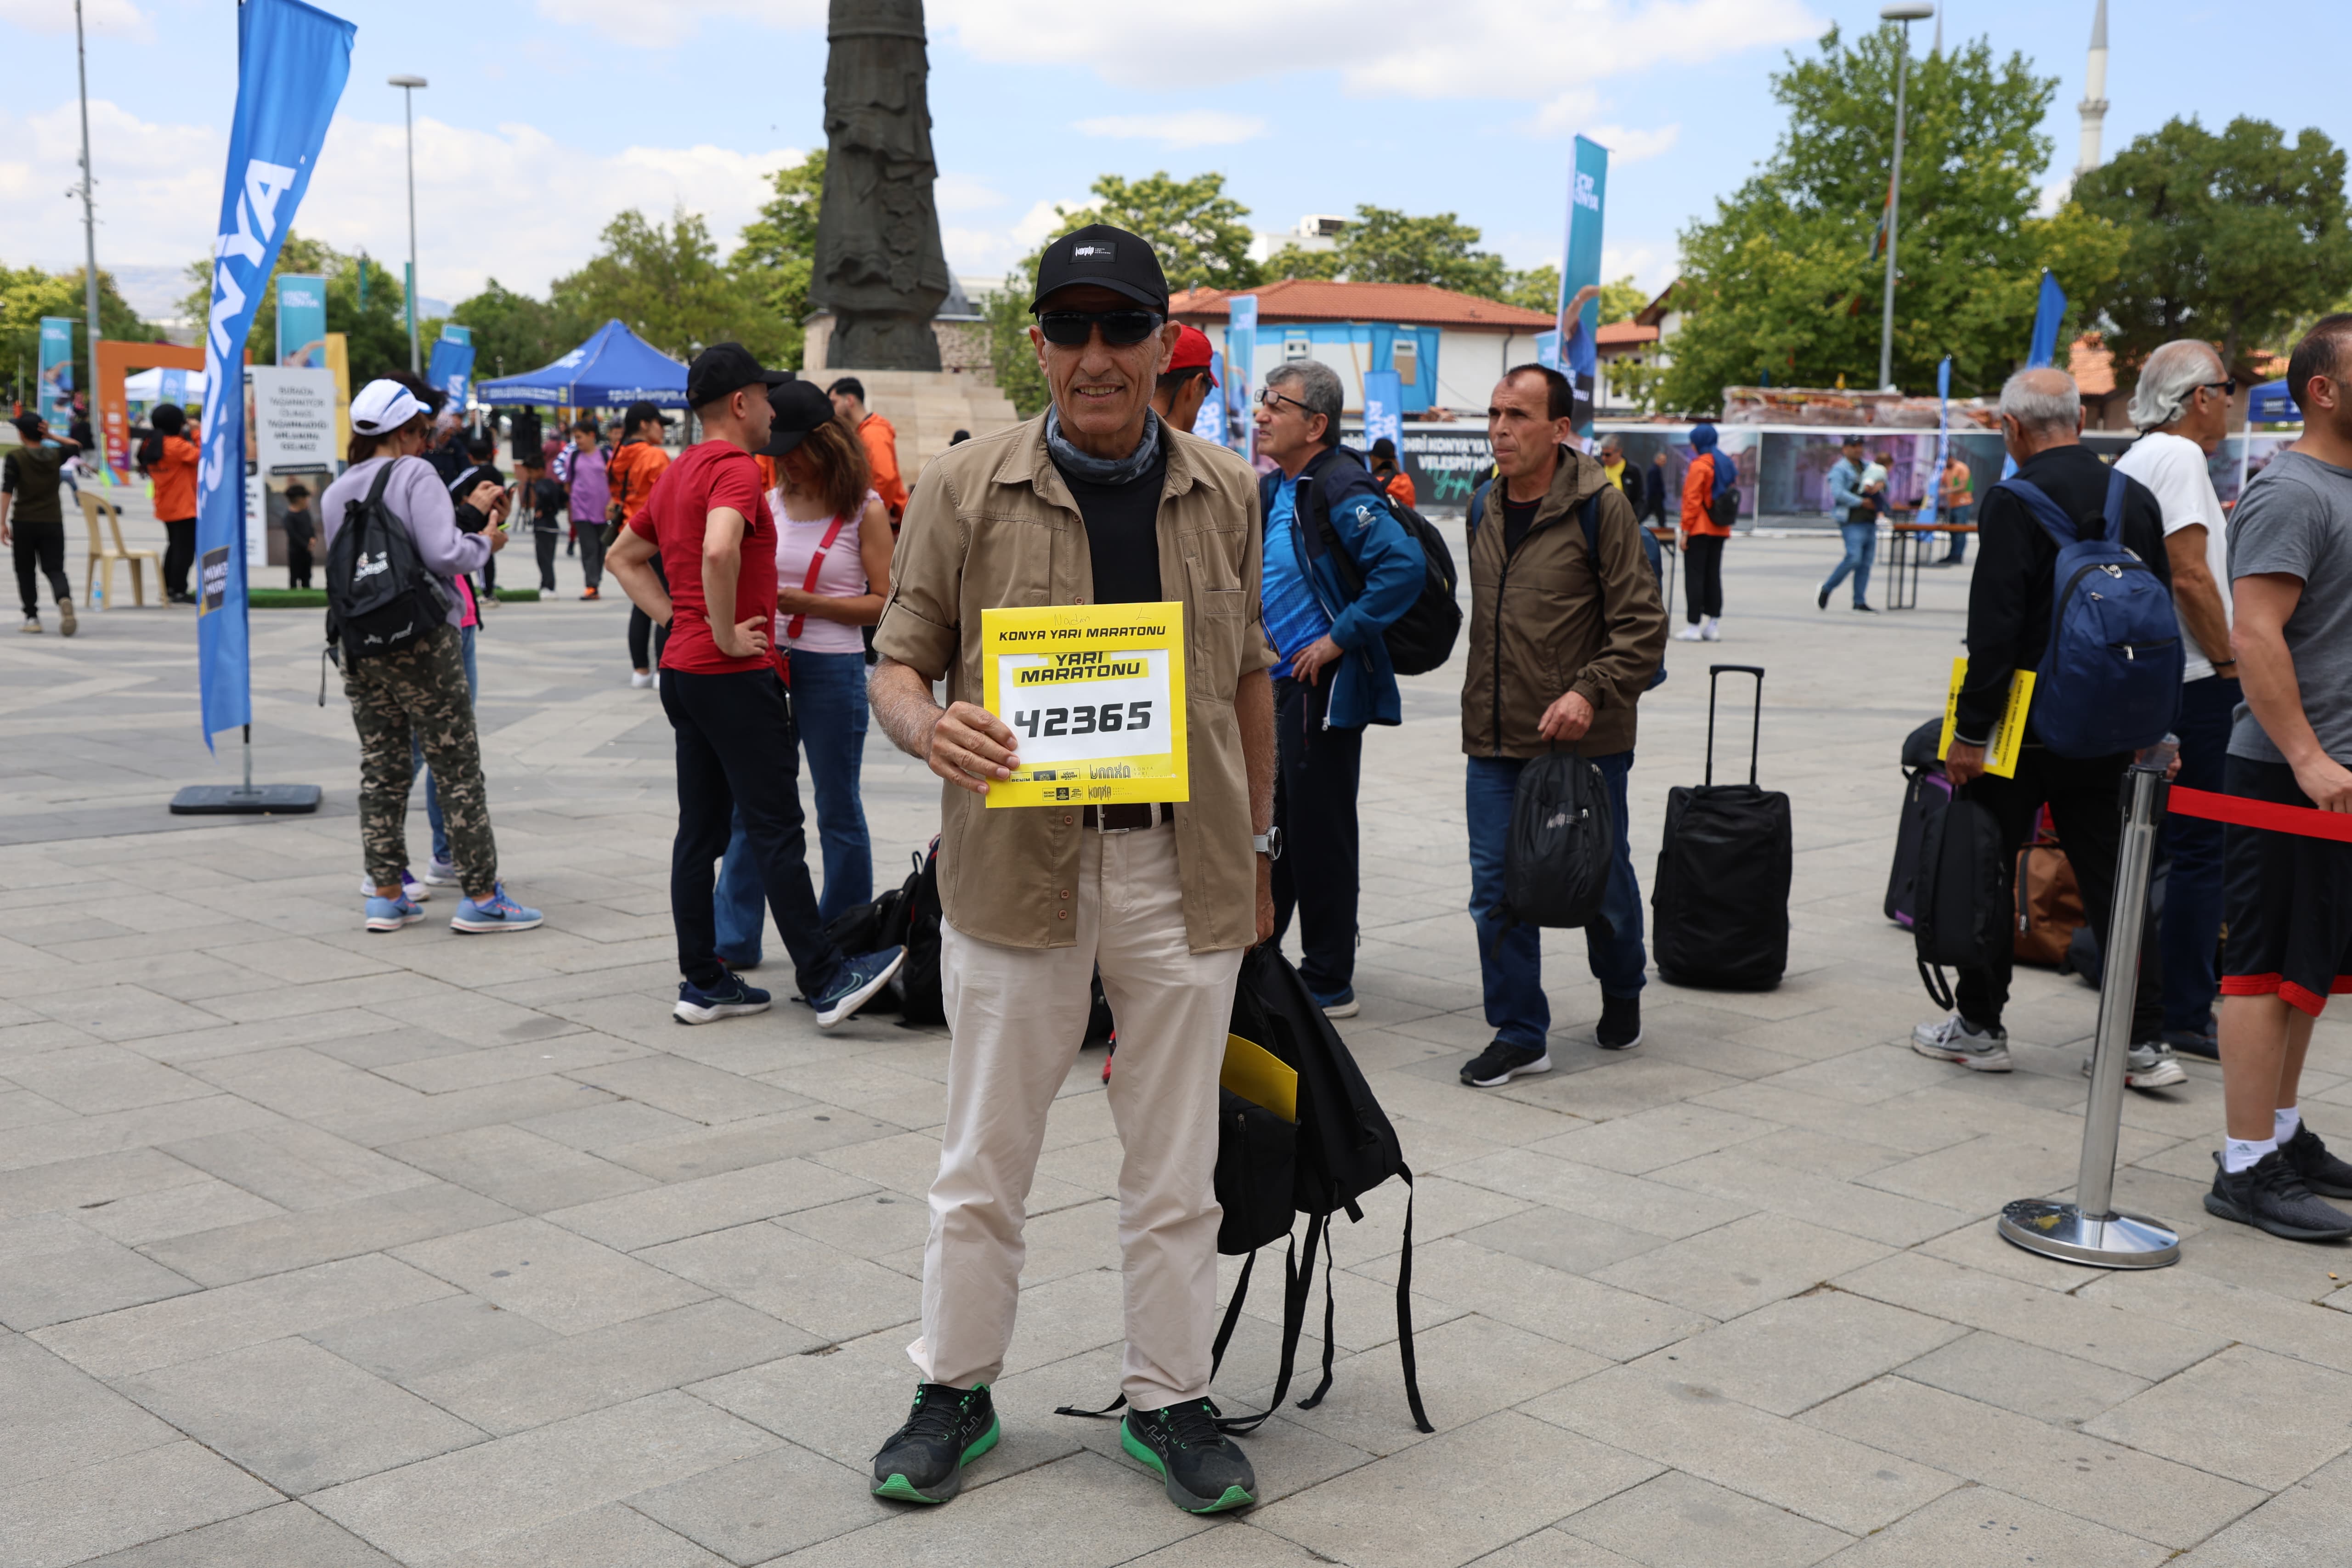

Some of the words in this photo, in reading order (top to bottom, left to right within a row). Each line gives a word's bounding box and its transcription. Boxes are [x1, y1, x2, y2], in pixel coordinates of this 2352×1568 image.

[999, 630, 1046, 641] KONYA
[1050, 628, 1082, 639] YARI
[1086, 626, 1166, 638] MARATONU
[1055, 651, 1103, 667] YARI
[1021, 662, 1140, 683] MARATONU
[1014, 701, 1152, 738] 42365
